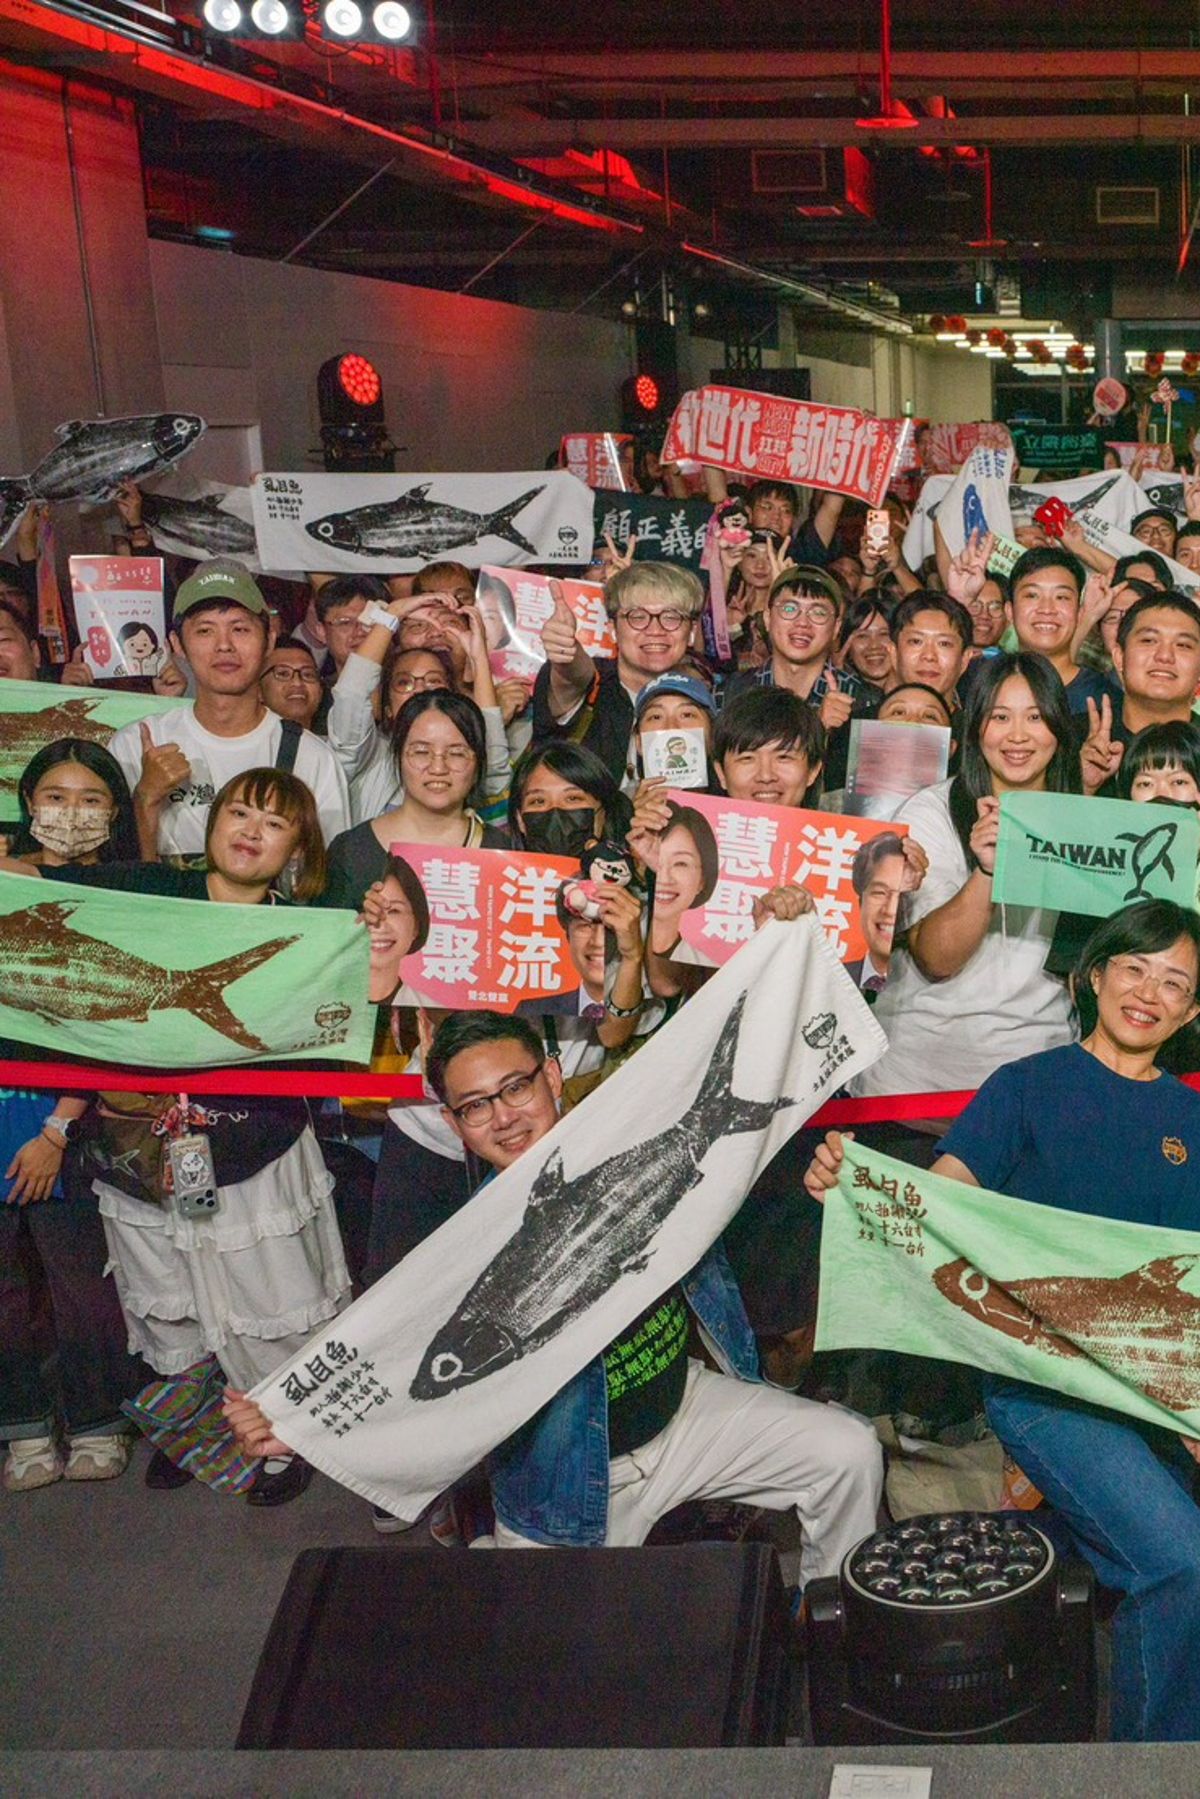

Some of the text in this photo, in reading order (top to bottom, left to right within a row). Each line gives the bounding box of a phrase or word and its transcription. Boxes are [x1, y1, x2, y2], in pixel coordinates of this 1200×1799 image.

[787, 405, 880, 493] 新時代
[1026, 834, 1127, 869] TAIWAN
[852, 1166, 928, 1219] 虱目魚
[280, 1340, 359, 1406] 虱目魚
[324, 1361, 375, 1405] 拍謝少年
[340, 1376, 380, 1411] 十六台寸
[353, 1386, 393, 1422] 十一台斤
